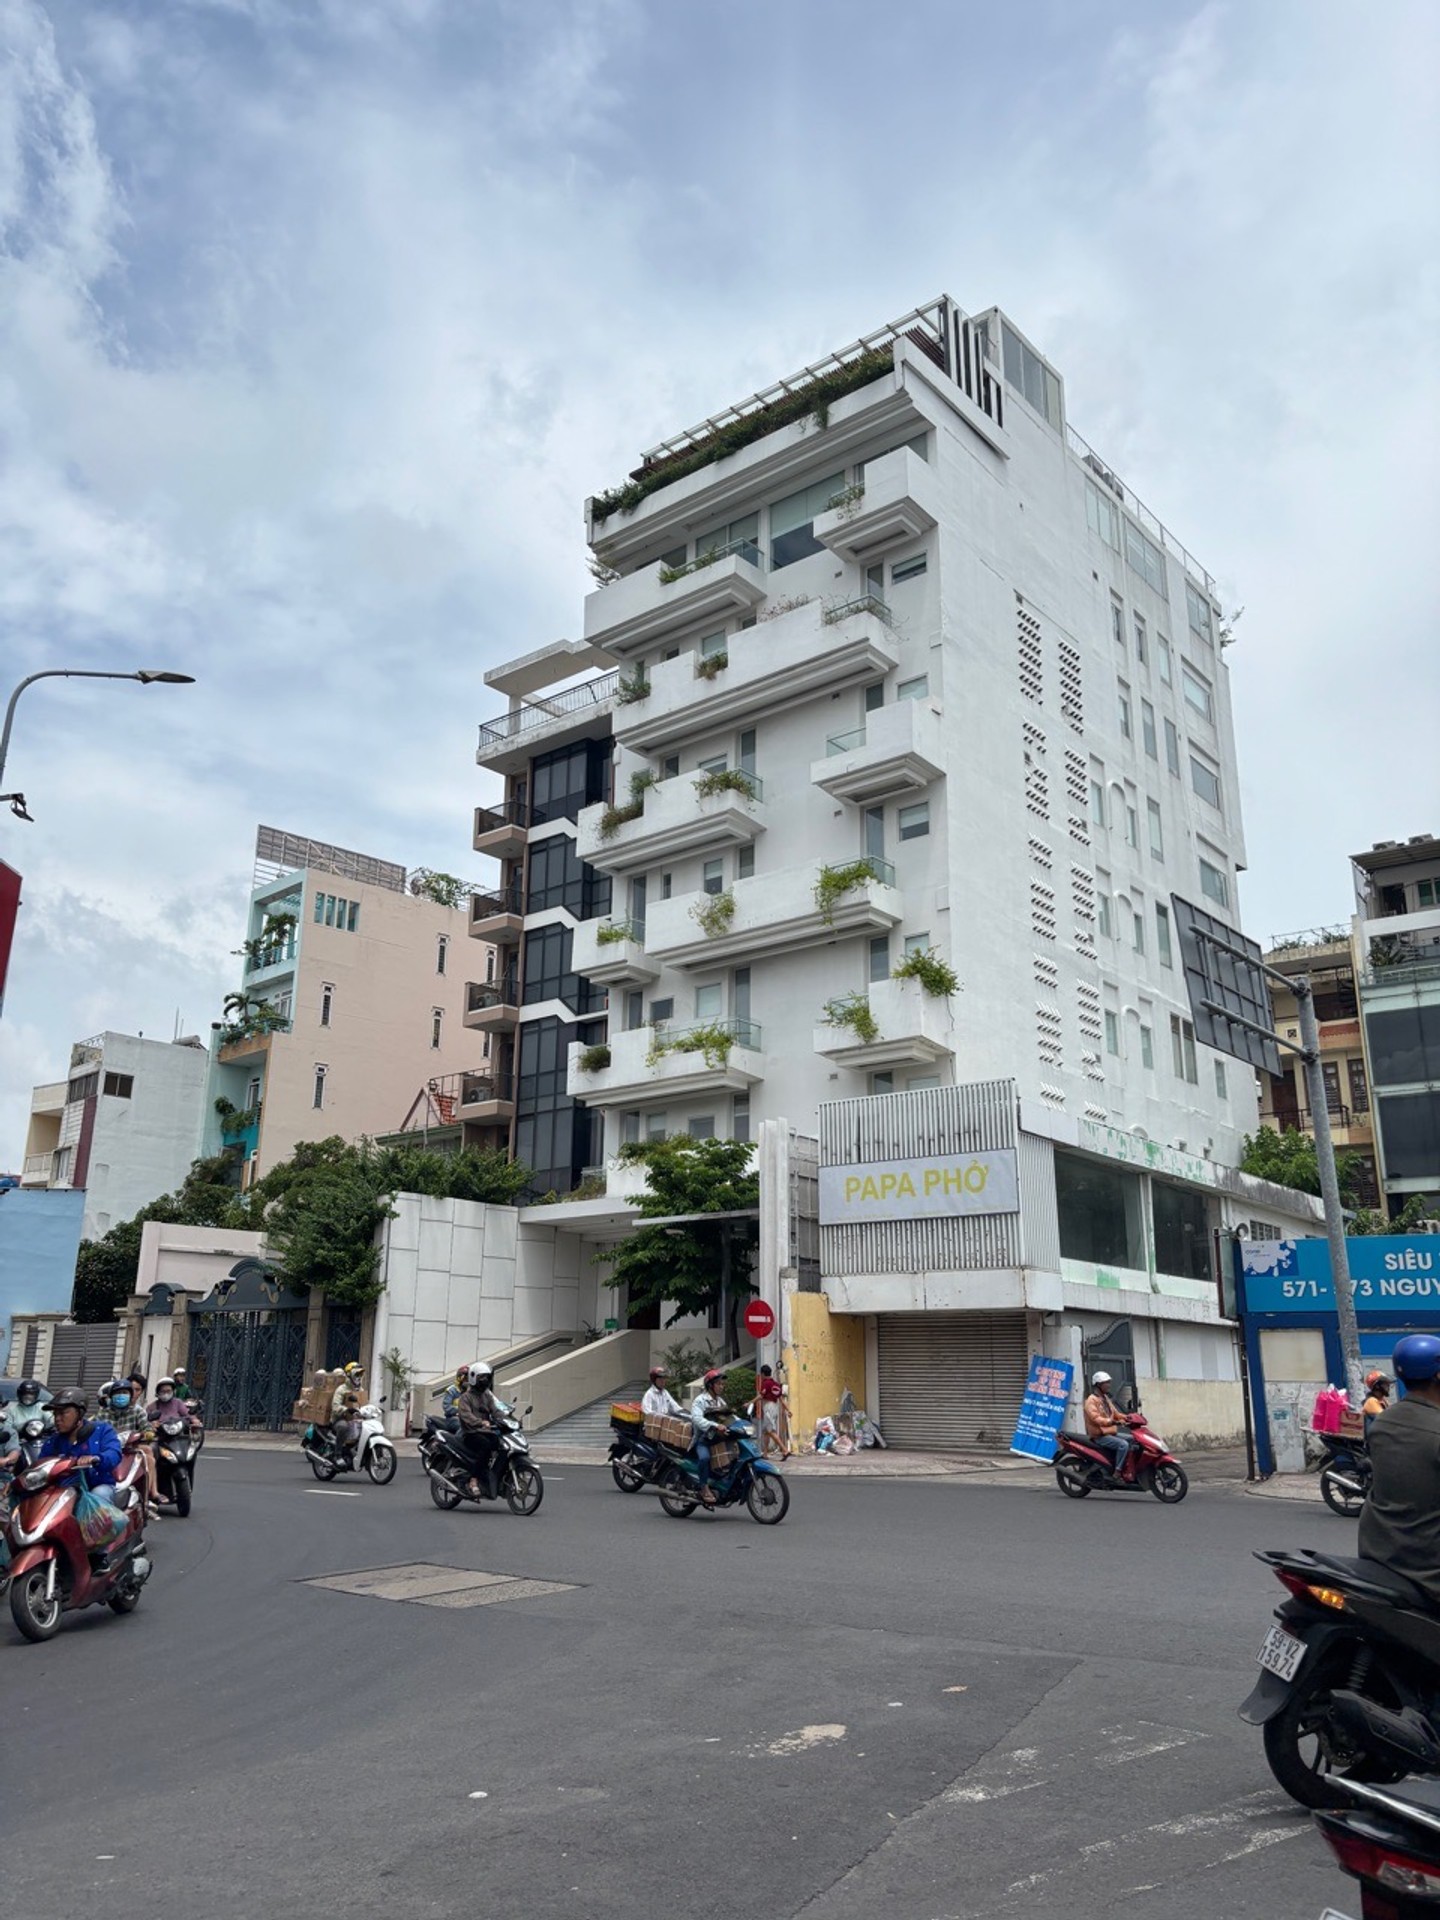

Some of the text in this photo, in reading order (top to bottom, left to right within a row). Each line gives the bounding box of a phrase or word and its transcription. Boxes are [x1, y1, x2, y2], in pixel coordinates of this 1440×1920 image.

[845, 1159, 989, 1202] PAPA PHỞ
[1384, 1248, 1433, 1271] SIÊU
[1334, 1278, 1374, 1297] 73
[1259, 1645, 1295, 1678] 159.74
